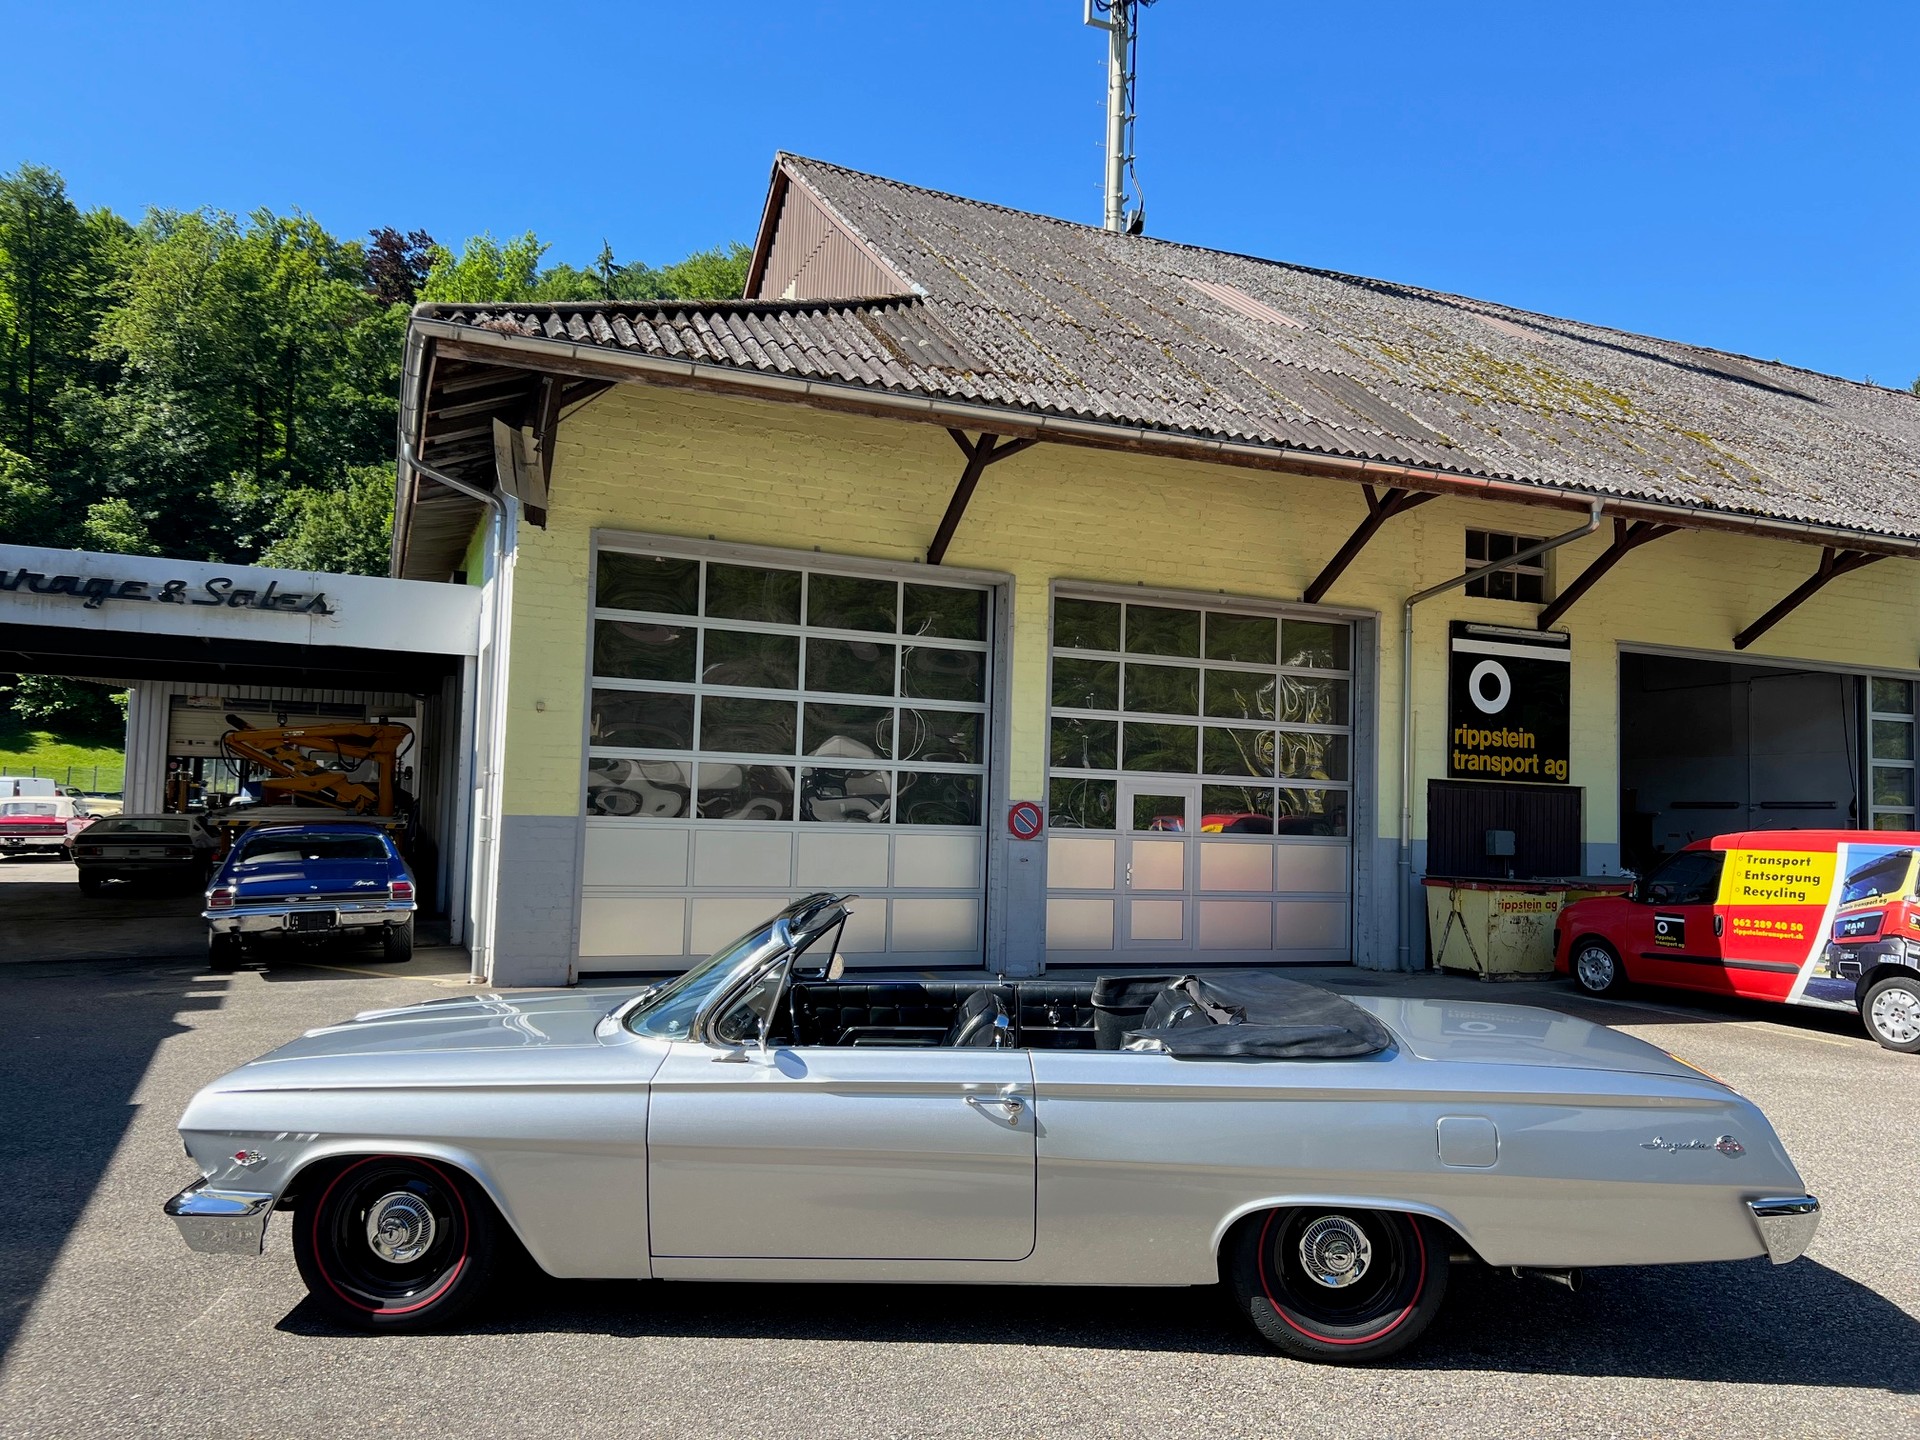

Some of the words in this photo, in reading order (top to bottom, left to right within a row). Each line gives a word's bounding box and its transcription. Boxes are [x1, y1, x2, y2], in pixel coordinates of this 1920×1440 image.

[157, 579, 187, 604] &
[192, 577, 335, 615] Sales
[1454, 723, 1535, 750] rippstein
[1453, 749, 1539, 777] transport
[1544, 758, 1568, 781] ag
[1746, 854, 1812, 869] Transport
[1744, 870, 1821, 887] Entsorgung
[1743, 886, 1806, 902] Recycling
[1545, 901, 1558, 912] ag
[1732, 918, 1751, 928] 062
[1753, 919, 1772, 929] 289
[1774, 921, 1788, 931] 40
[1790, 922, 1804, 932] 50
[1844, 921, 1865, 931] MAN
